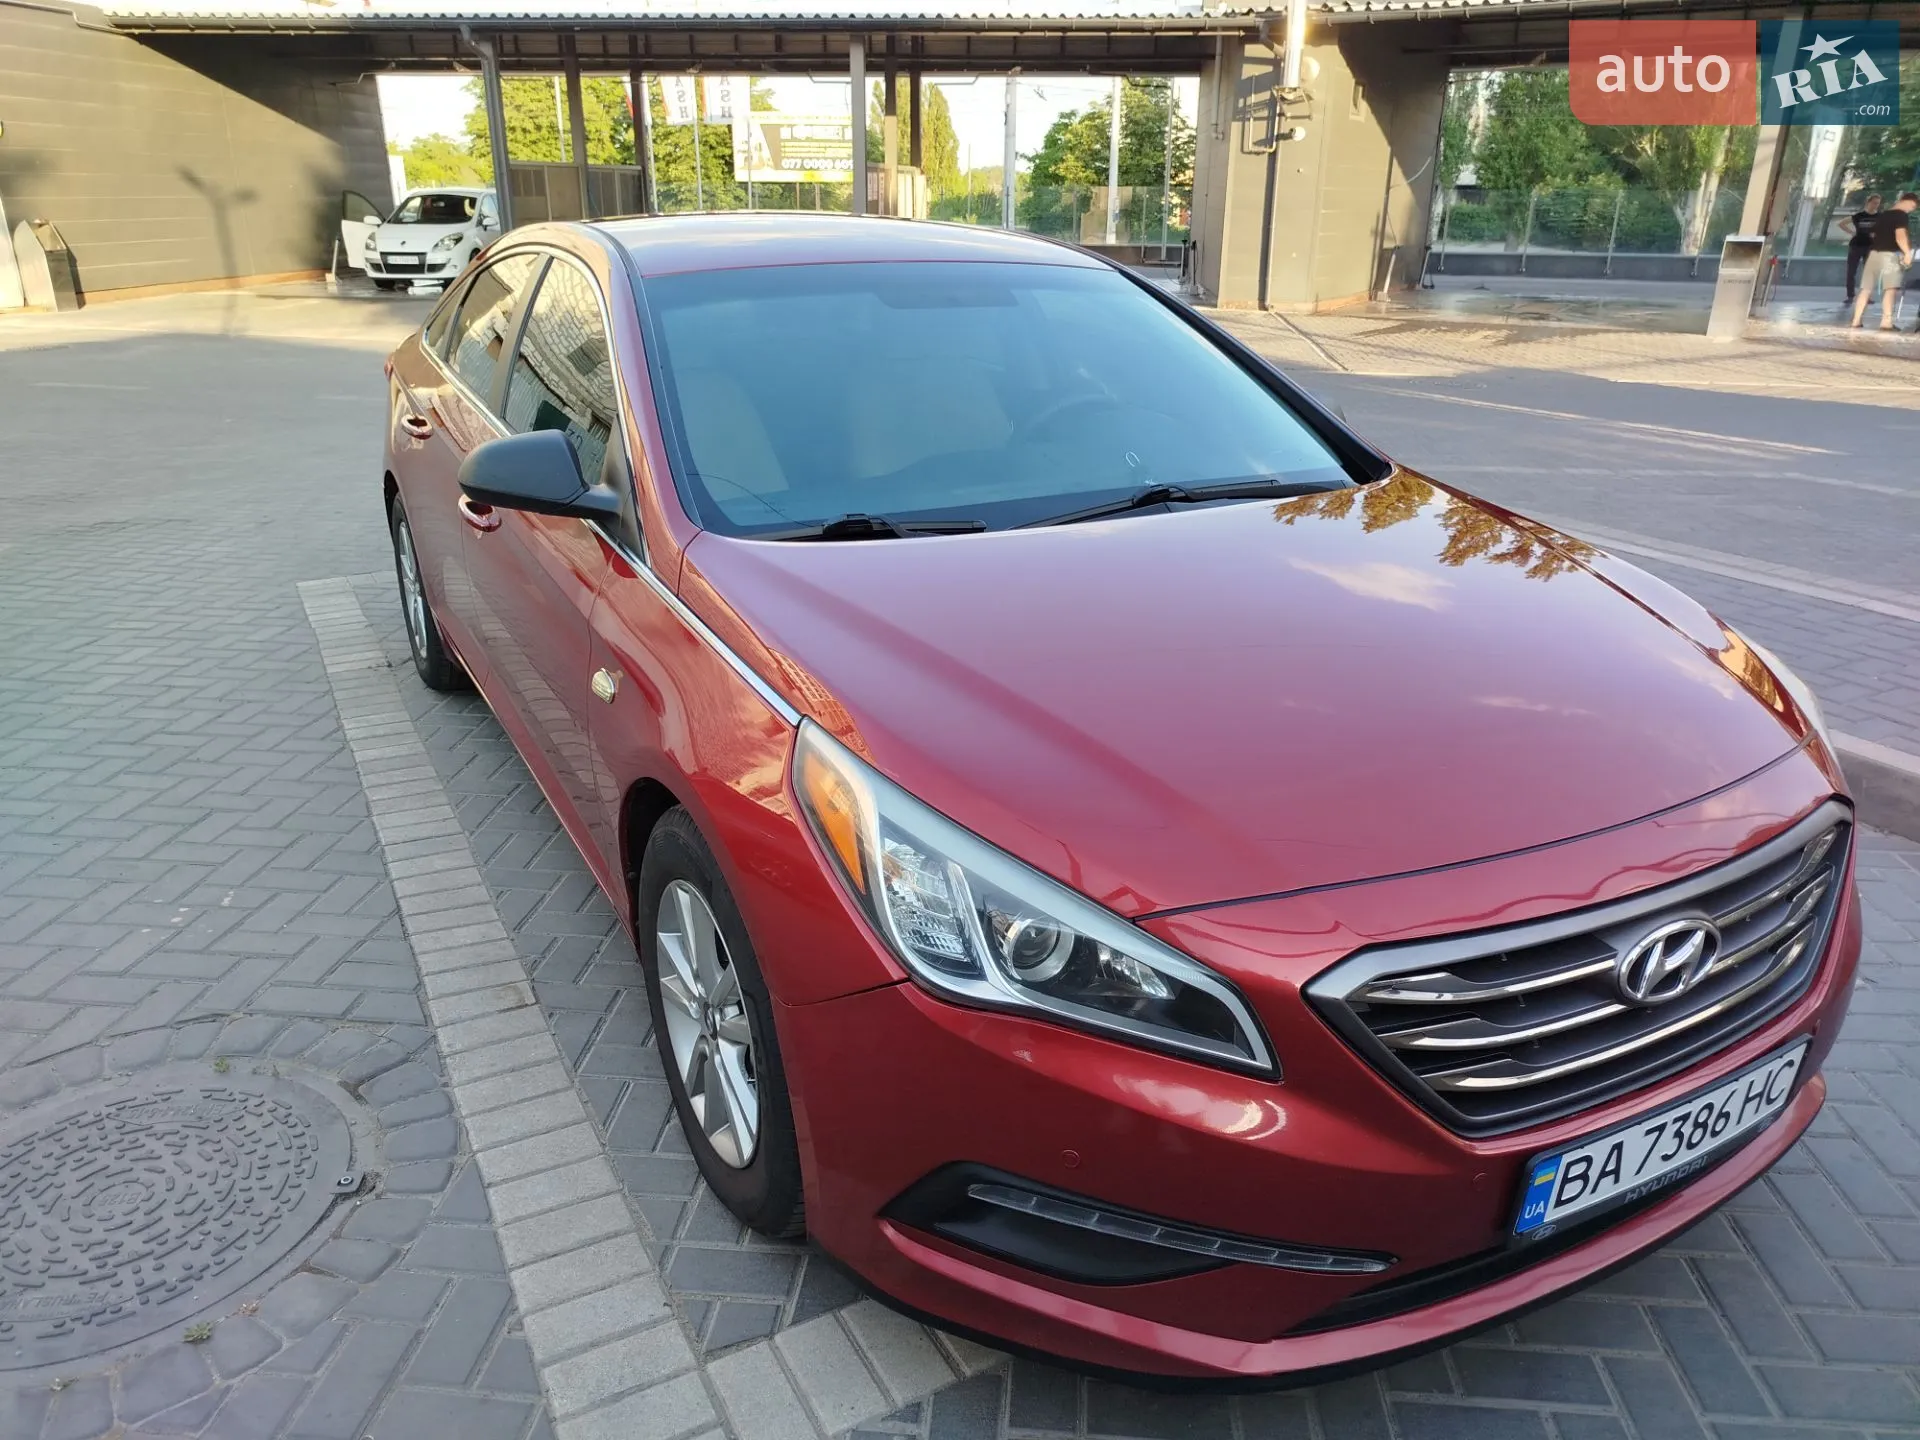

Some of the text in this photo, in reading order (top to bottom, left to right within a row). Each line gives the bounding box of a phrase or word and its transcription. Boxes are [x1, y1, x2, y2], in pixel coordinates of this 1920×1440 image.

[1553, 1059, 1795, 1210] BA 7386 HC
[1623, 1155, 1709, 1204] HYUNDAI
[1524, 1201, 1545, 1219] UA
